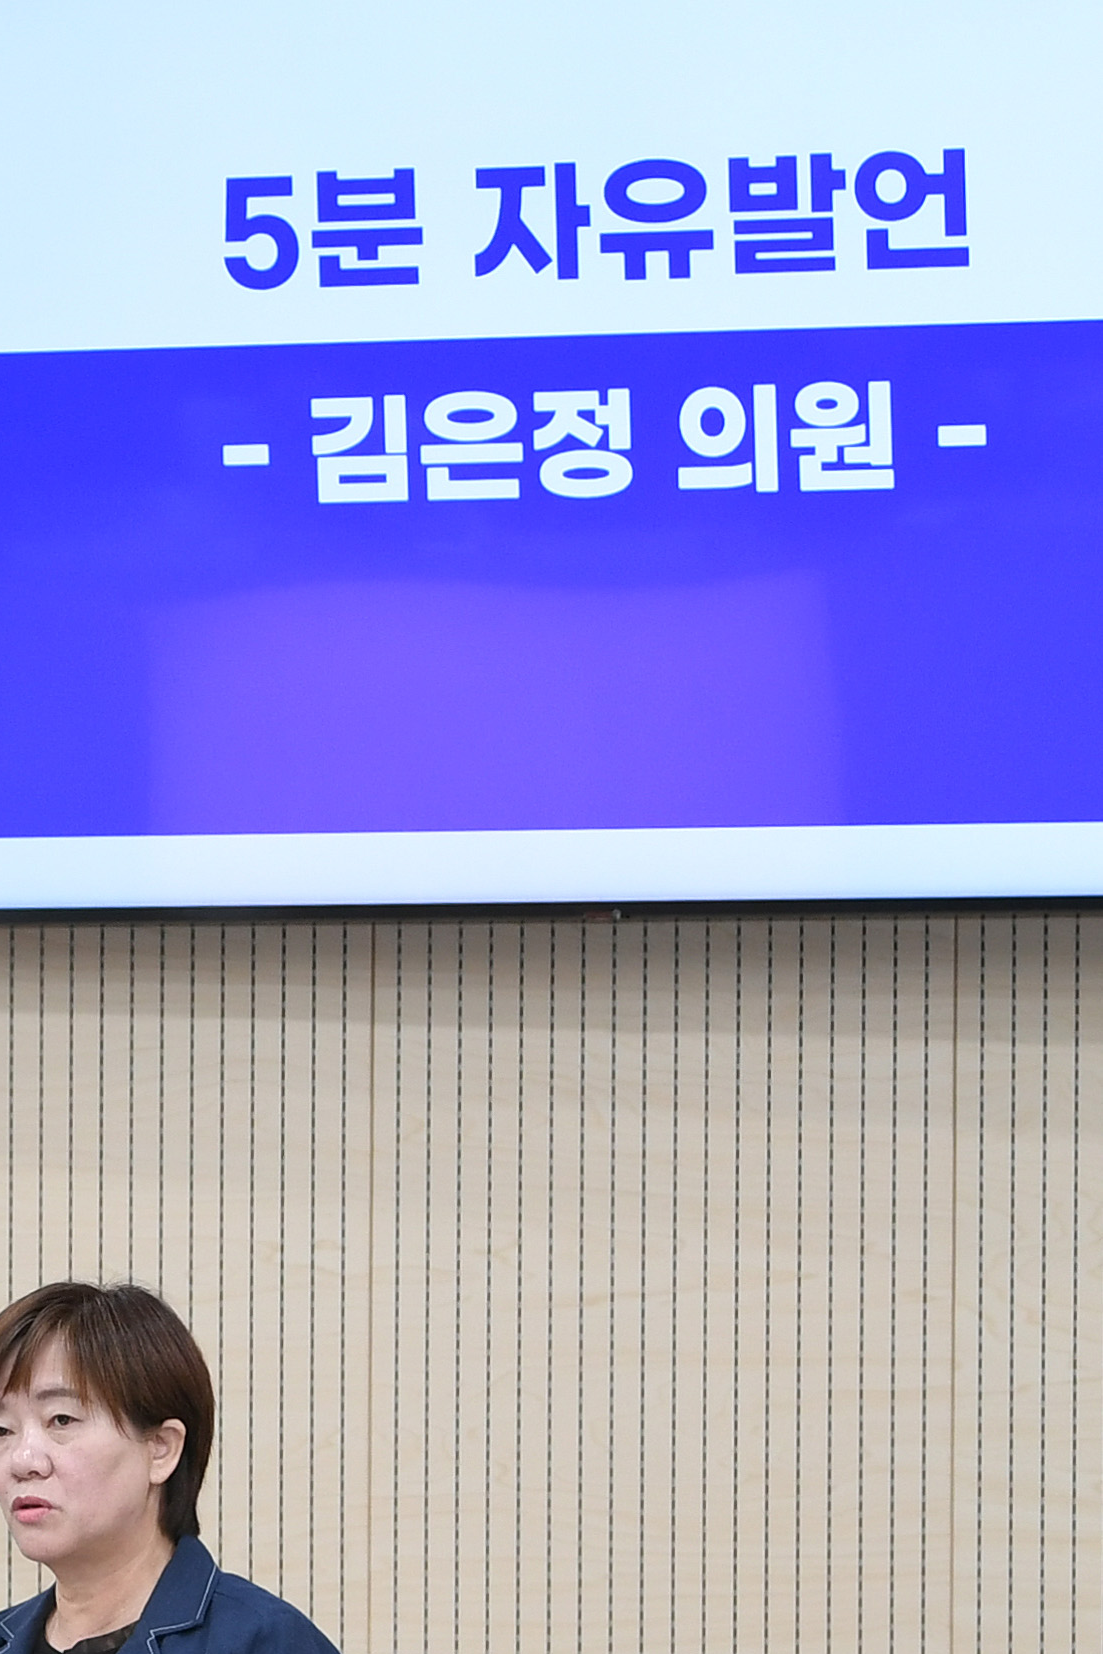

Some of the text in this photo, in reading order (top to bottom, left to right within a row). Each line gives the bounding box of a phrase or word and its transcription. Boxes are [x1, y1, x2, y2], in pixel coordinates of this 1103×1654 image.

[223, 147, 970, 291] 5분 자유발언
[310, 388, 633, 503] 김은정
[678, 380, 895, 493] 의원
